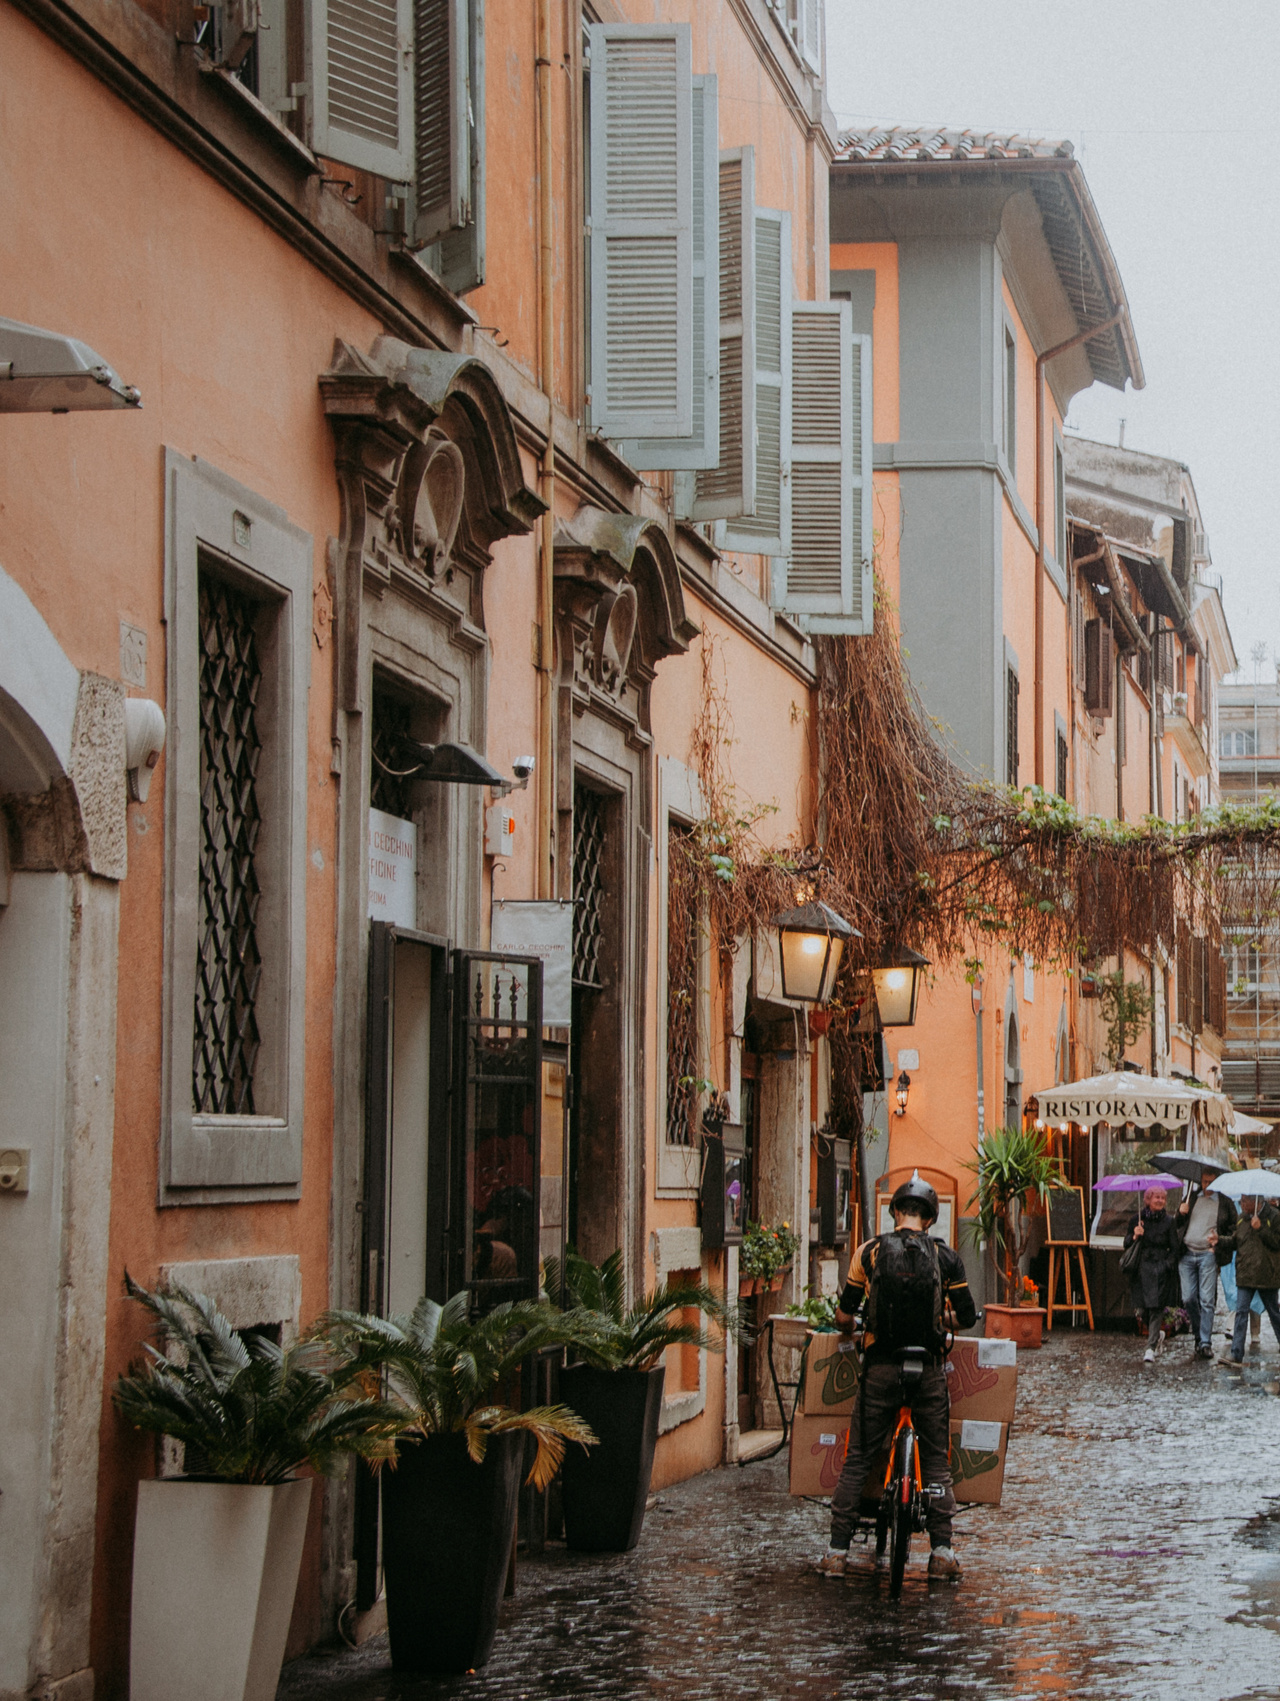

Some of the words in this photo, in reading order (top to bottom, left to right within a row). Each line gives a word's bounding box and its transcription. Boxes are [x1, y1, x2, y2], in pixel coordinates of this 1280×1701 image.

[374, 830, 414, 860] CECCHINI
[497, 943, 525, 951] CARLO
[528, 943, 566, 952] CECCHINI
[1045, 1099, 1189, 1120] RISTORANTE
